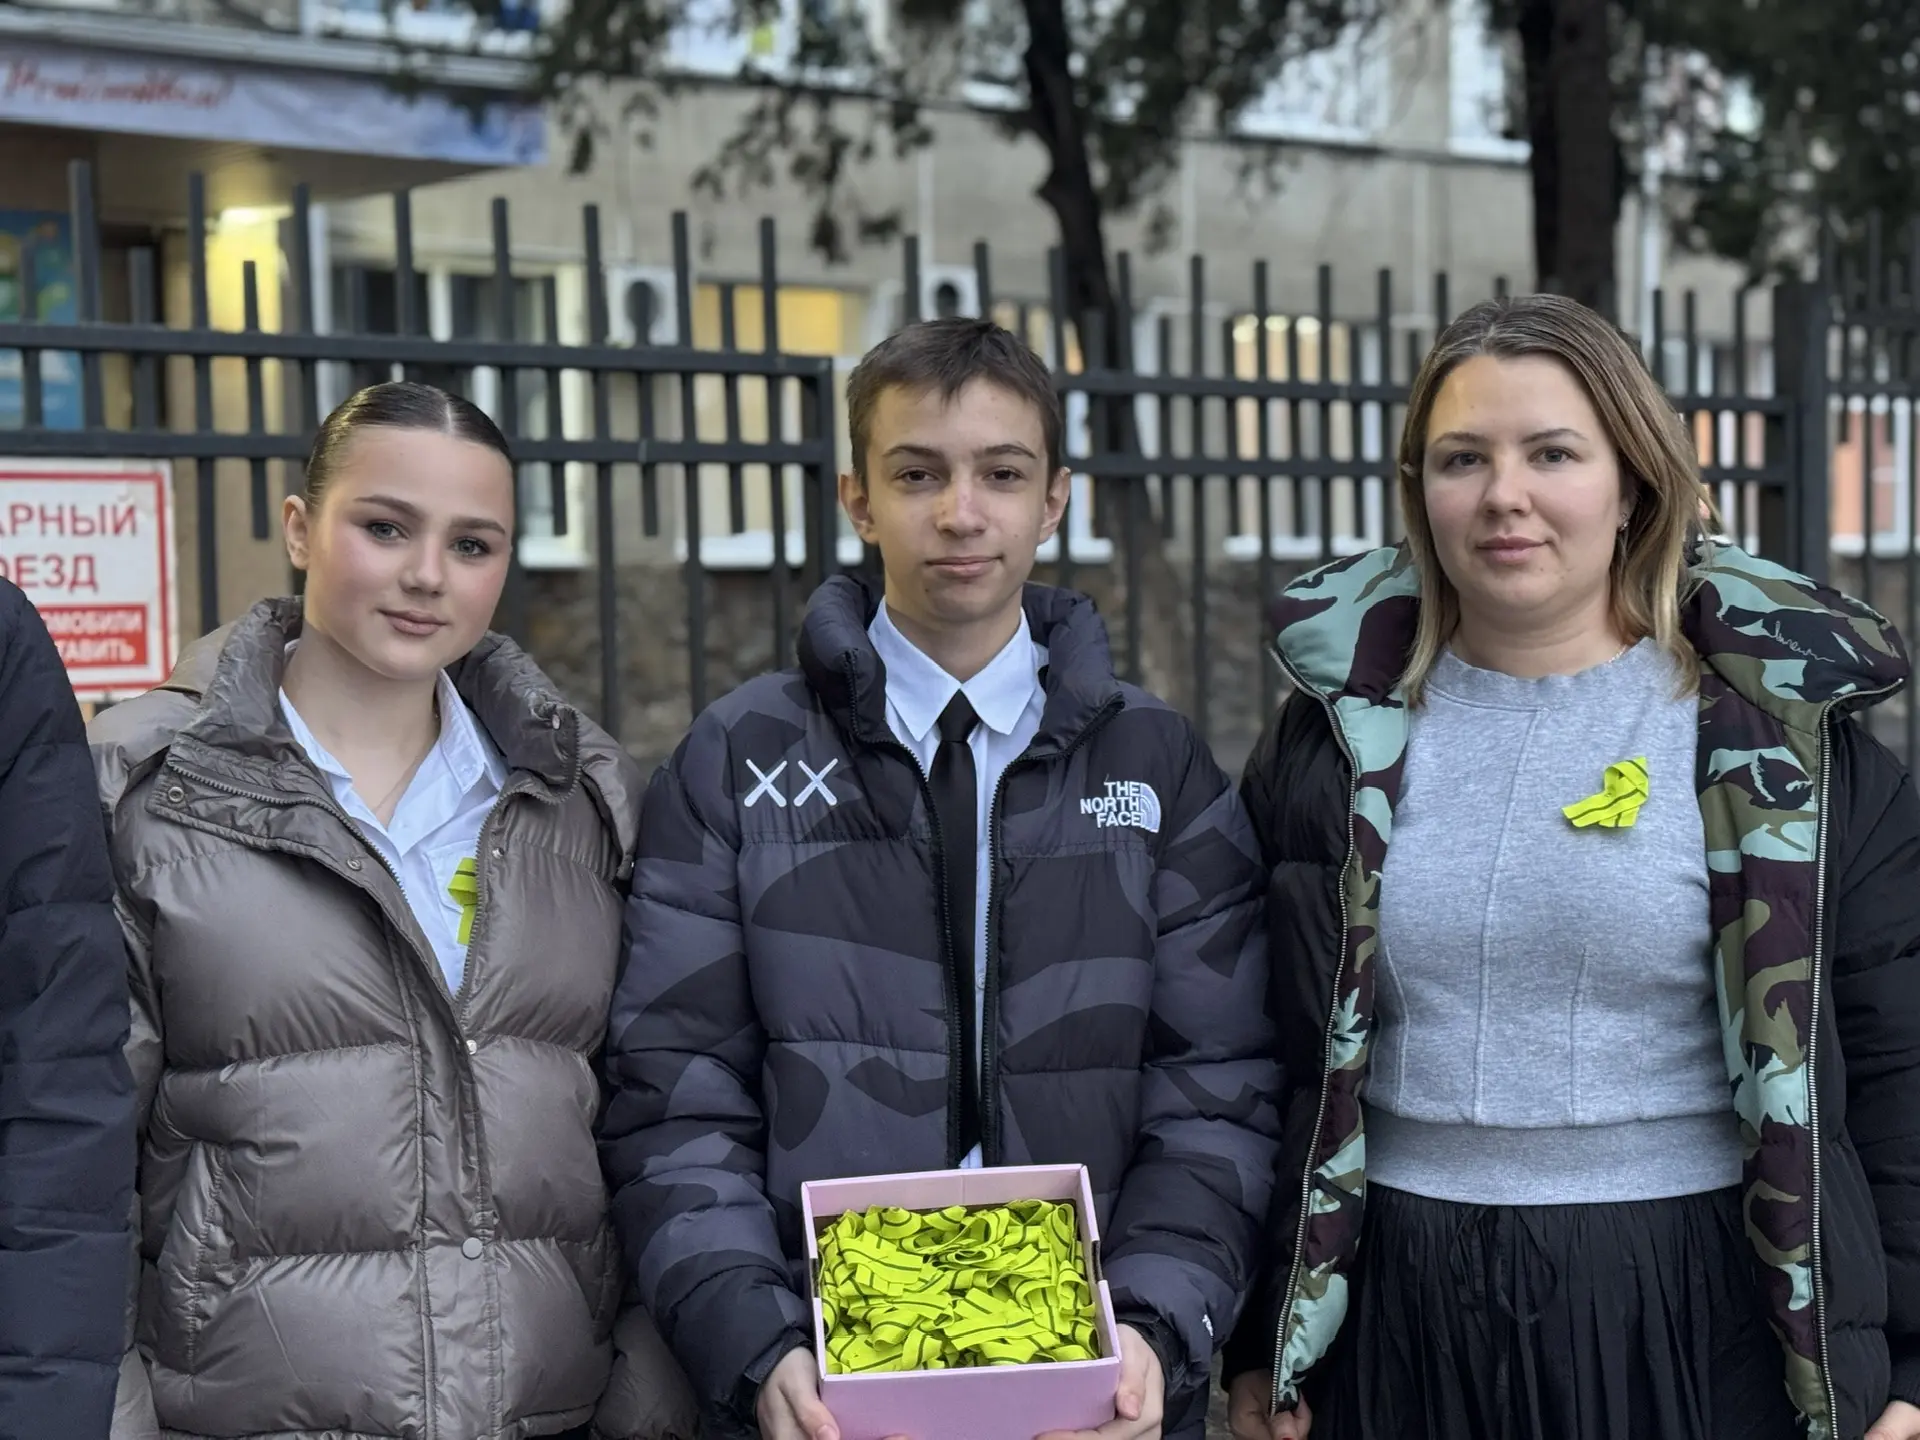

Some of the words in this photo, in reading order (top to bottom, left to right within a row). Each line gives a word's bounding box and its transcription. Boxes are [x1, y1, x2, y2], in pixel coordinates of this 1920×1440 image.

[0, 495, 137, 536] РНЫЙ
[1103, 780, 1141, 797] THE
[1080, 796, 1140, 814] NORTH
[1096, 811, 1142, 828] FACE
